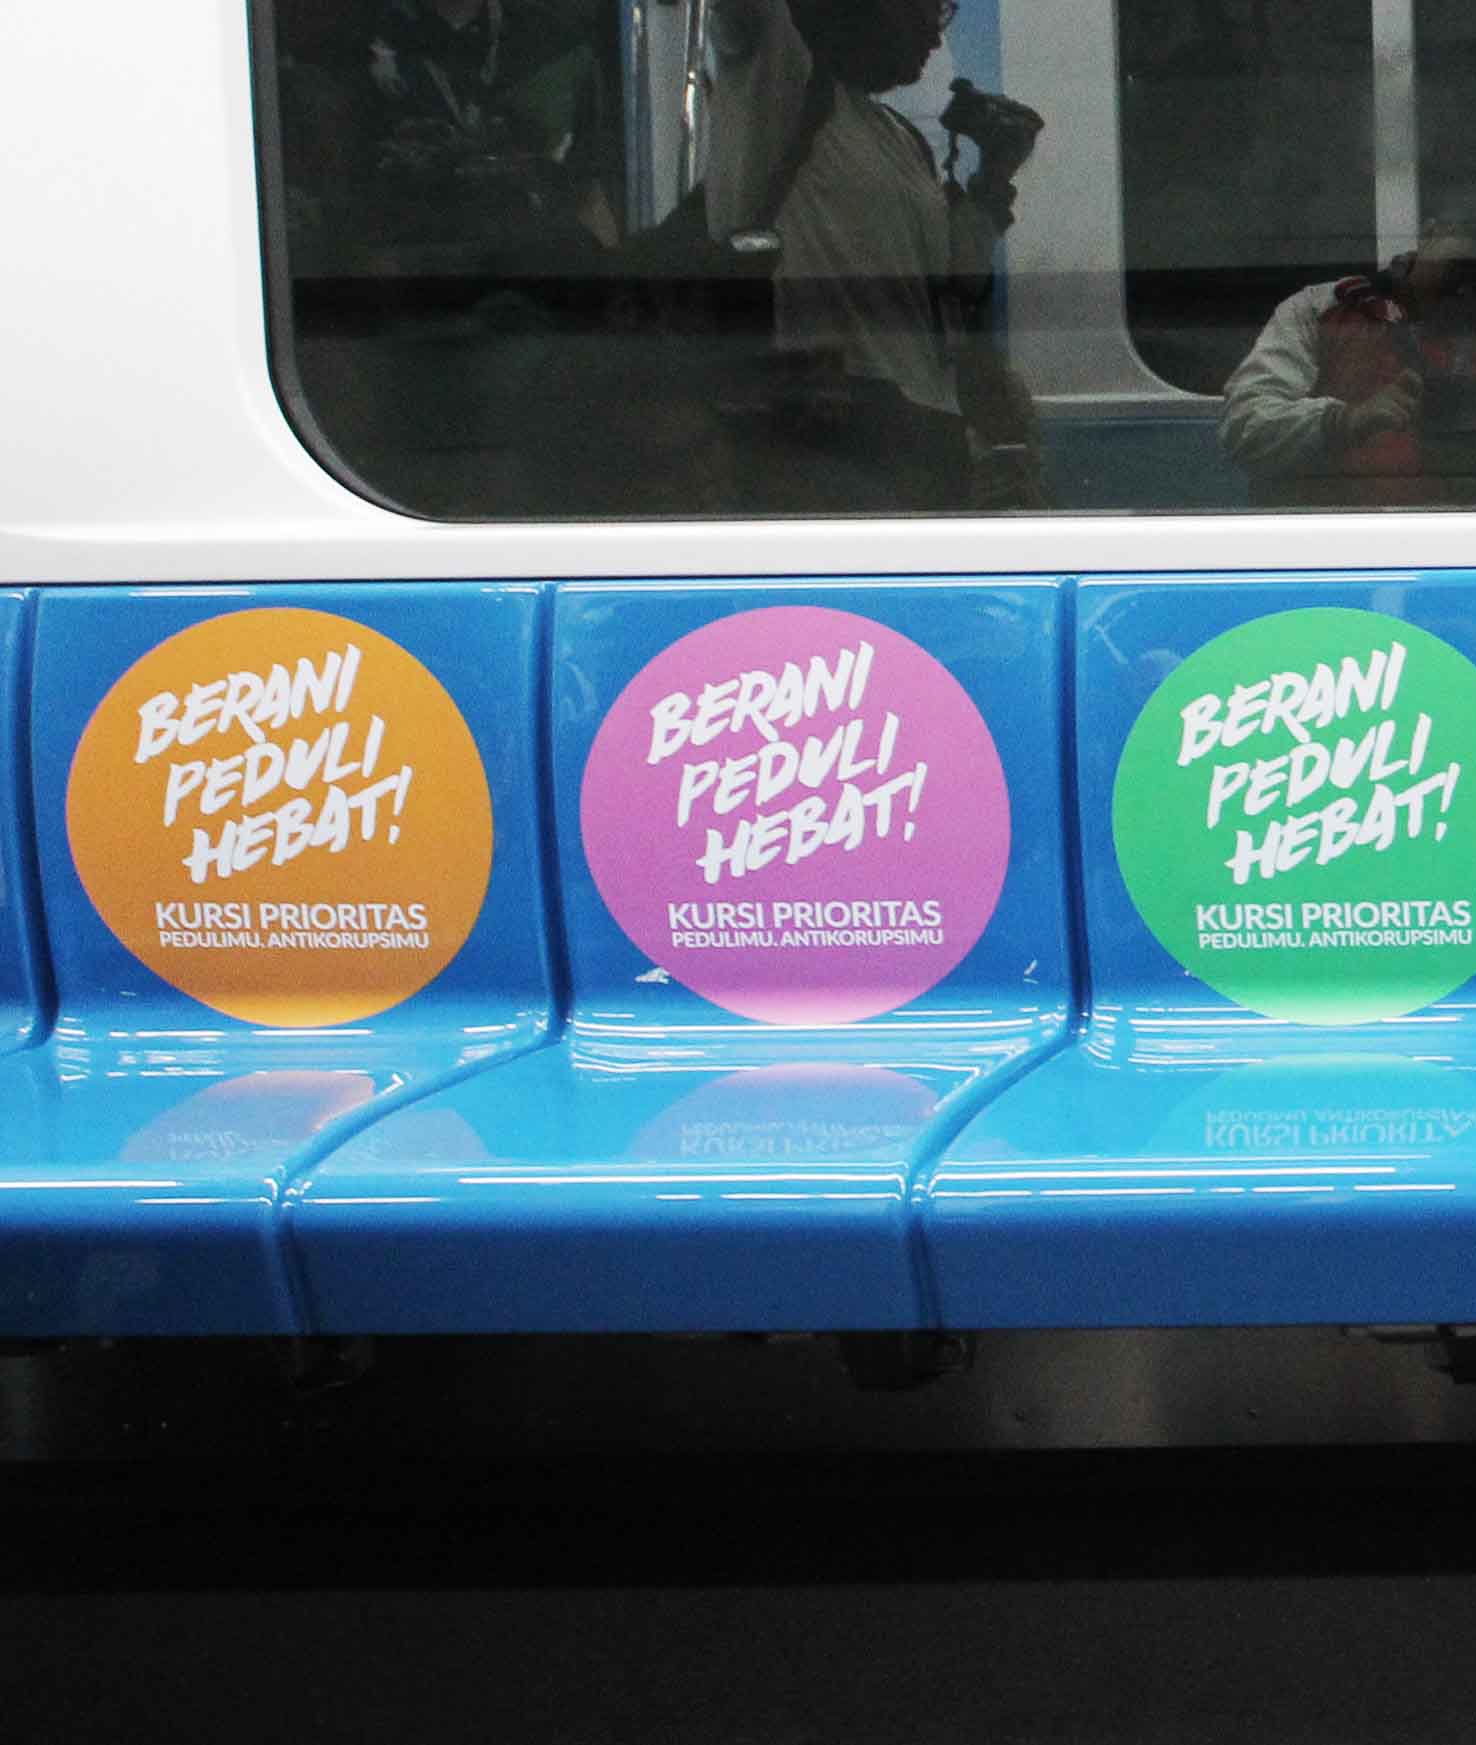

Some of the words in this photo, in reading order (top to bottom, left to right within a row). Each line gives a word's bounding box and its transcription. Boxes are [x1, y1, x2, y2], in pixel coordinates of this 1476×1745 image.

[134, 643, 362, 764] BERANI
[646, 640, 875, 765] BERANI
[1177, 641, 1407, 767] BERANI
[164, 714, 385, 827] PEDULI
[183, 764, 412, 885] HEBAT!
[678, 711, 899, 828] PEDULI
[696, 762, 928, 884] HEBAT!
[1207, 712, 1432, 829] PEDULI
[1225, 762, 1460, 885] HEBAT!
[155, 902, 251, 930] KURSI
[260, 902, 428, 930] PRIORITAS
[266, 931, 430, 949] ANTIKORUPSIMU
[668, 902, 765, 930] KURSI
[773, 900, 941, 929] PRIORITAS
[780, 929, 944, 947] ANTIKORUPSIMU
[1196, 903, 1293, 931] KURSI
[1302, 901, 1471, 929] PRIORITAS
[1308, 929, 1472, 947] ANTIKORUPSIMU
